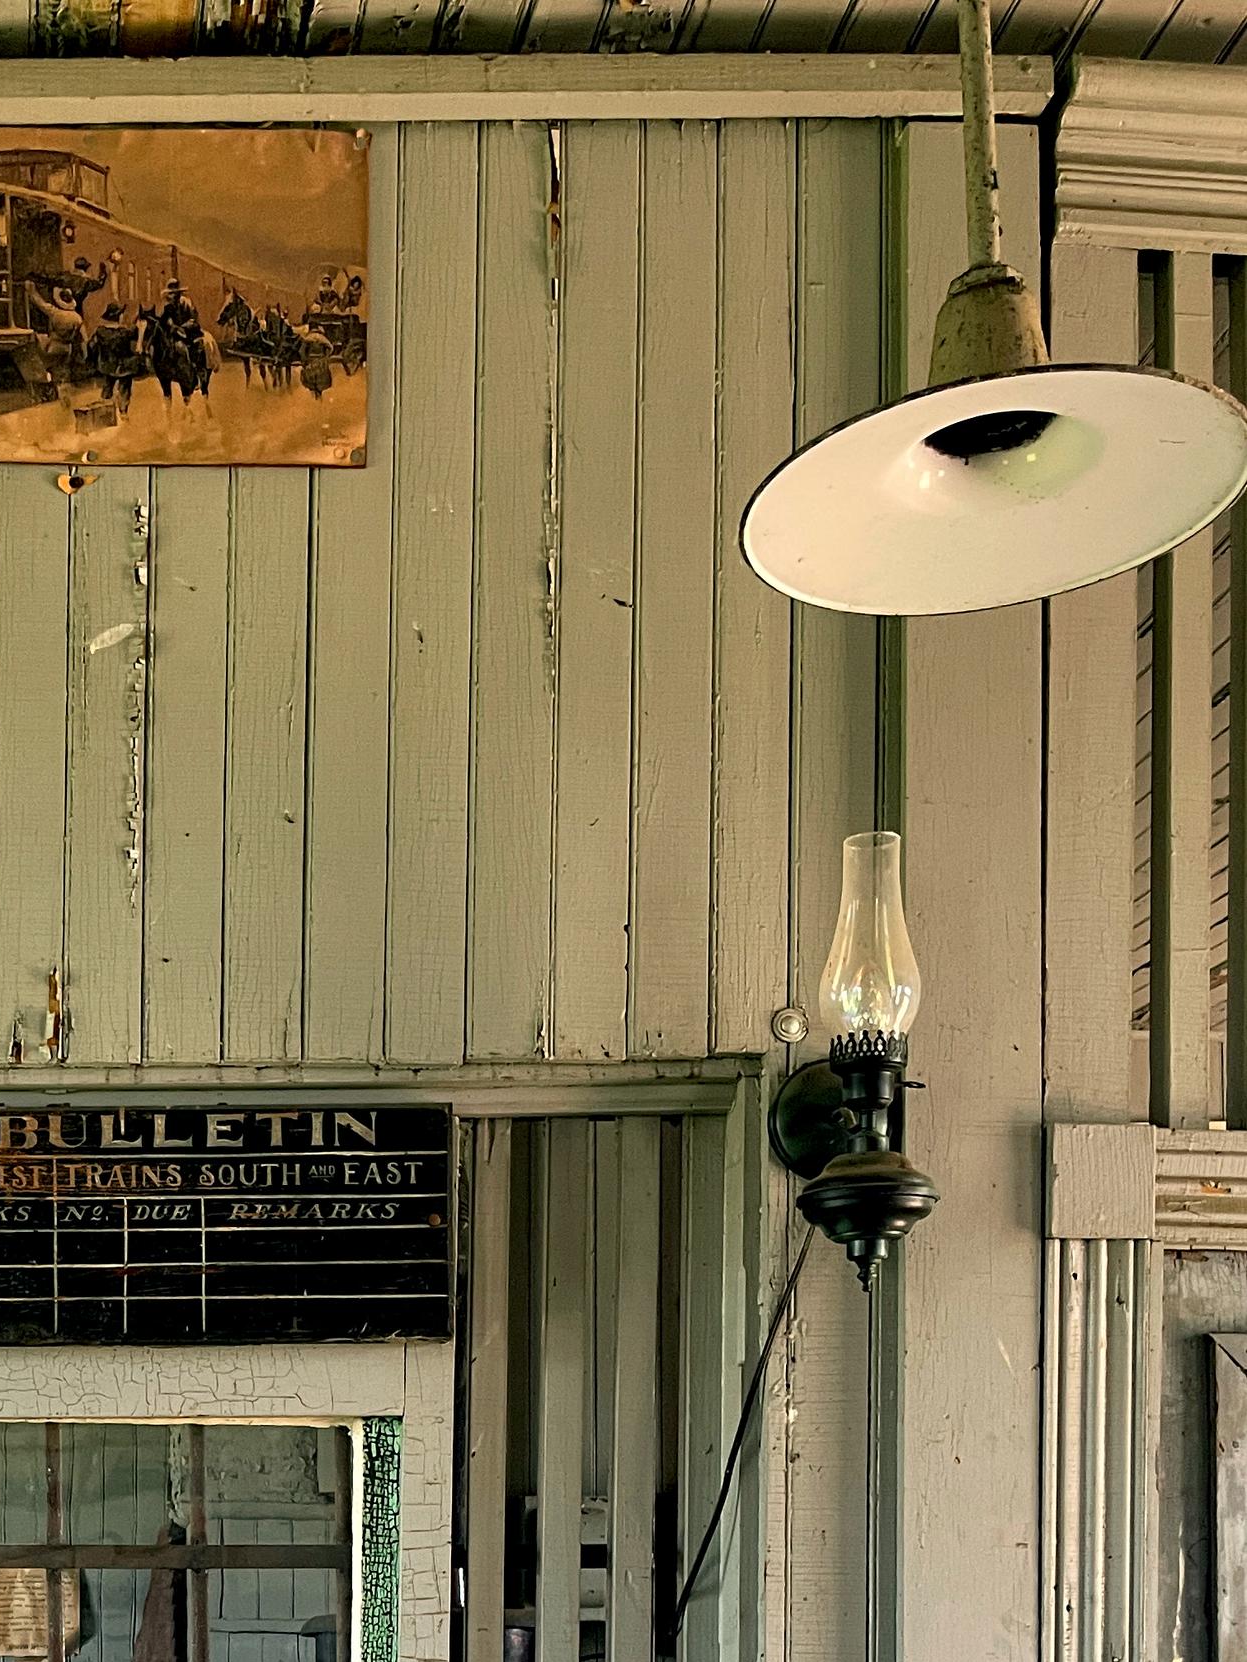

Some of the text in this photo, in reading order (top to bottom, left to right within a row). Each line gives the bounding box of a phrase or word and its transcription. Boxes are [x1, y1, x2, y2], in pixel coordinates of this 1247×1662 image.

[64, 1161, 424, 1188] TRAINS SOUTH AND EAST
[131, 1204, 192, 1221] DUE
[228, 1202, 401, 1220] REMARKS
